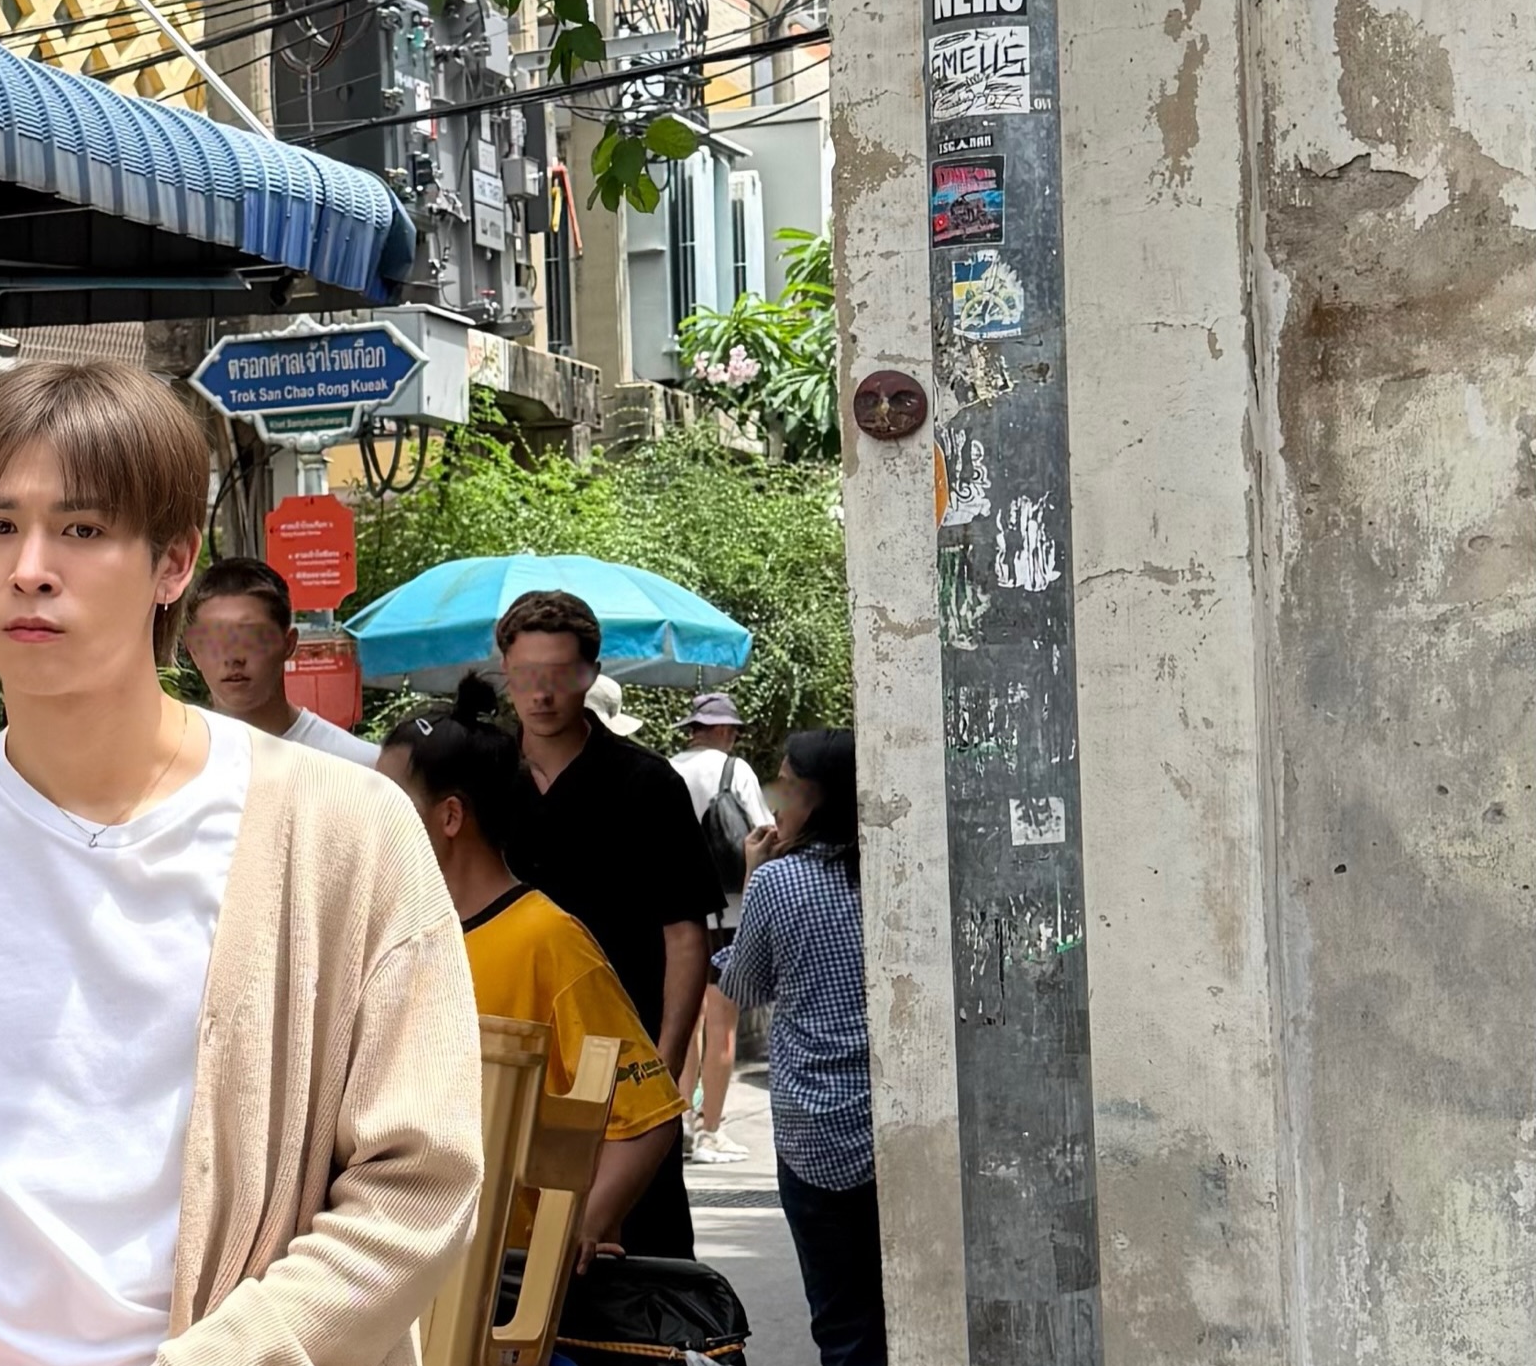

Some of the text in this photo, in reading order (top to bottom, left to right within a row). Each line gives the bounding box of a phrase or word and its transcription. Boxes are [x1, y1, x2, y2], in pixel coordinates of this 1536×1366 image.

[230, 389, 257, 404] Trok
[259, 387, 282, 402] San
[284, 385, 315, 400] Chao
[317, 382, 349, 398] Rong
